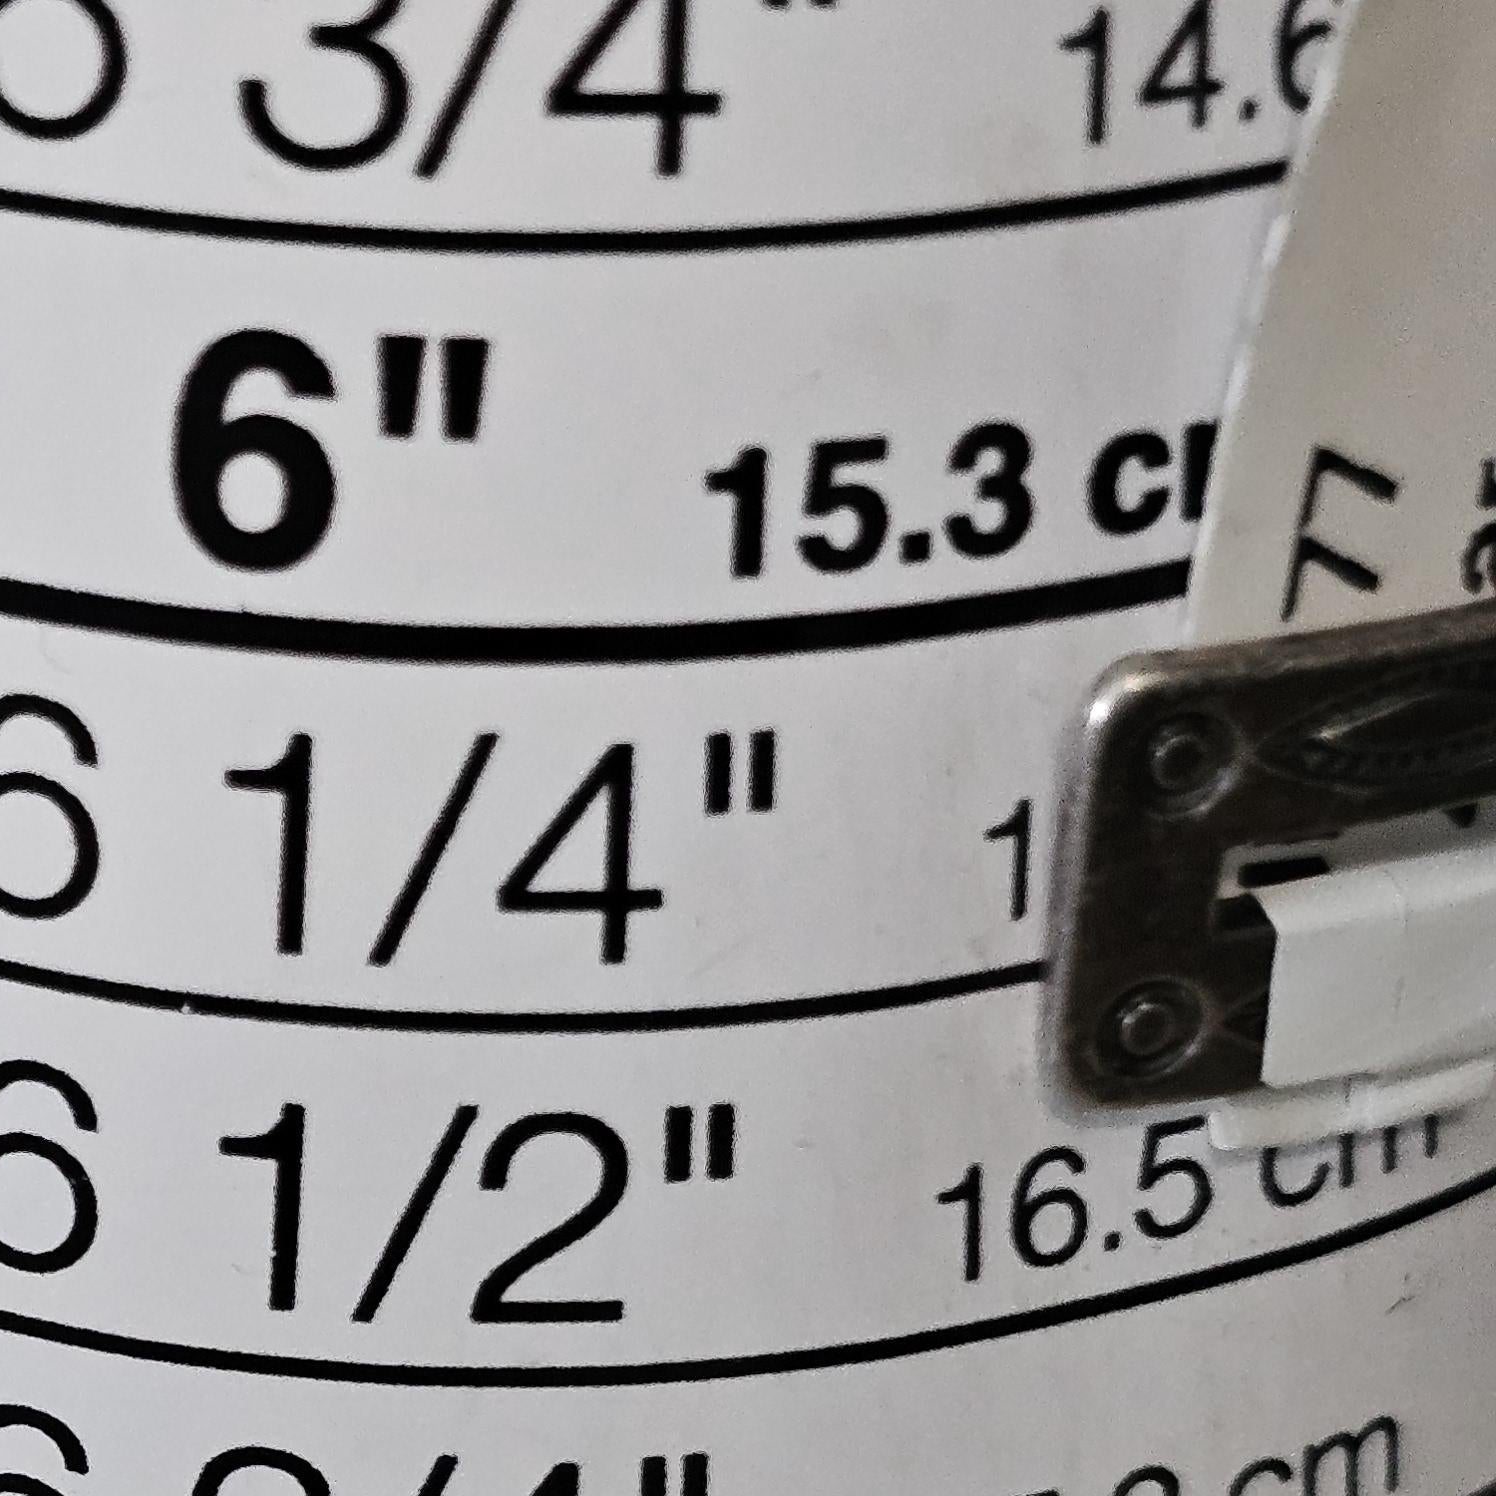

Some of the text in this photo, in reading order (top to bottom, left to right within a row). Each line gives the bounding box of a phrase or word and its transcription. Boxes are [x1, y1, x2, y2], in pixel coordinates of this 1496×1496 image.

[235, 0, 841, 182] 3/4
[168, 325, 1224, 582] 6" 15.3 c
[222, 724, 781, 970] 1/4"
[216, 1100, 738, 1327] 1/2"
[933, 1112, 1217, 1286] 16.5
